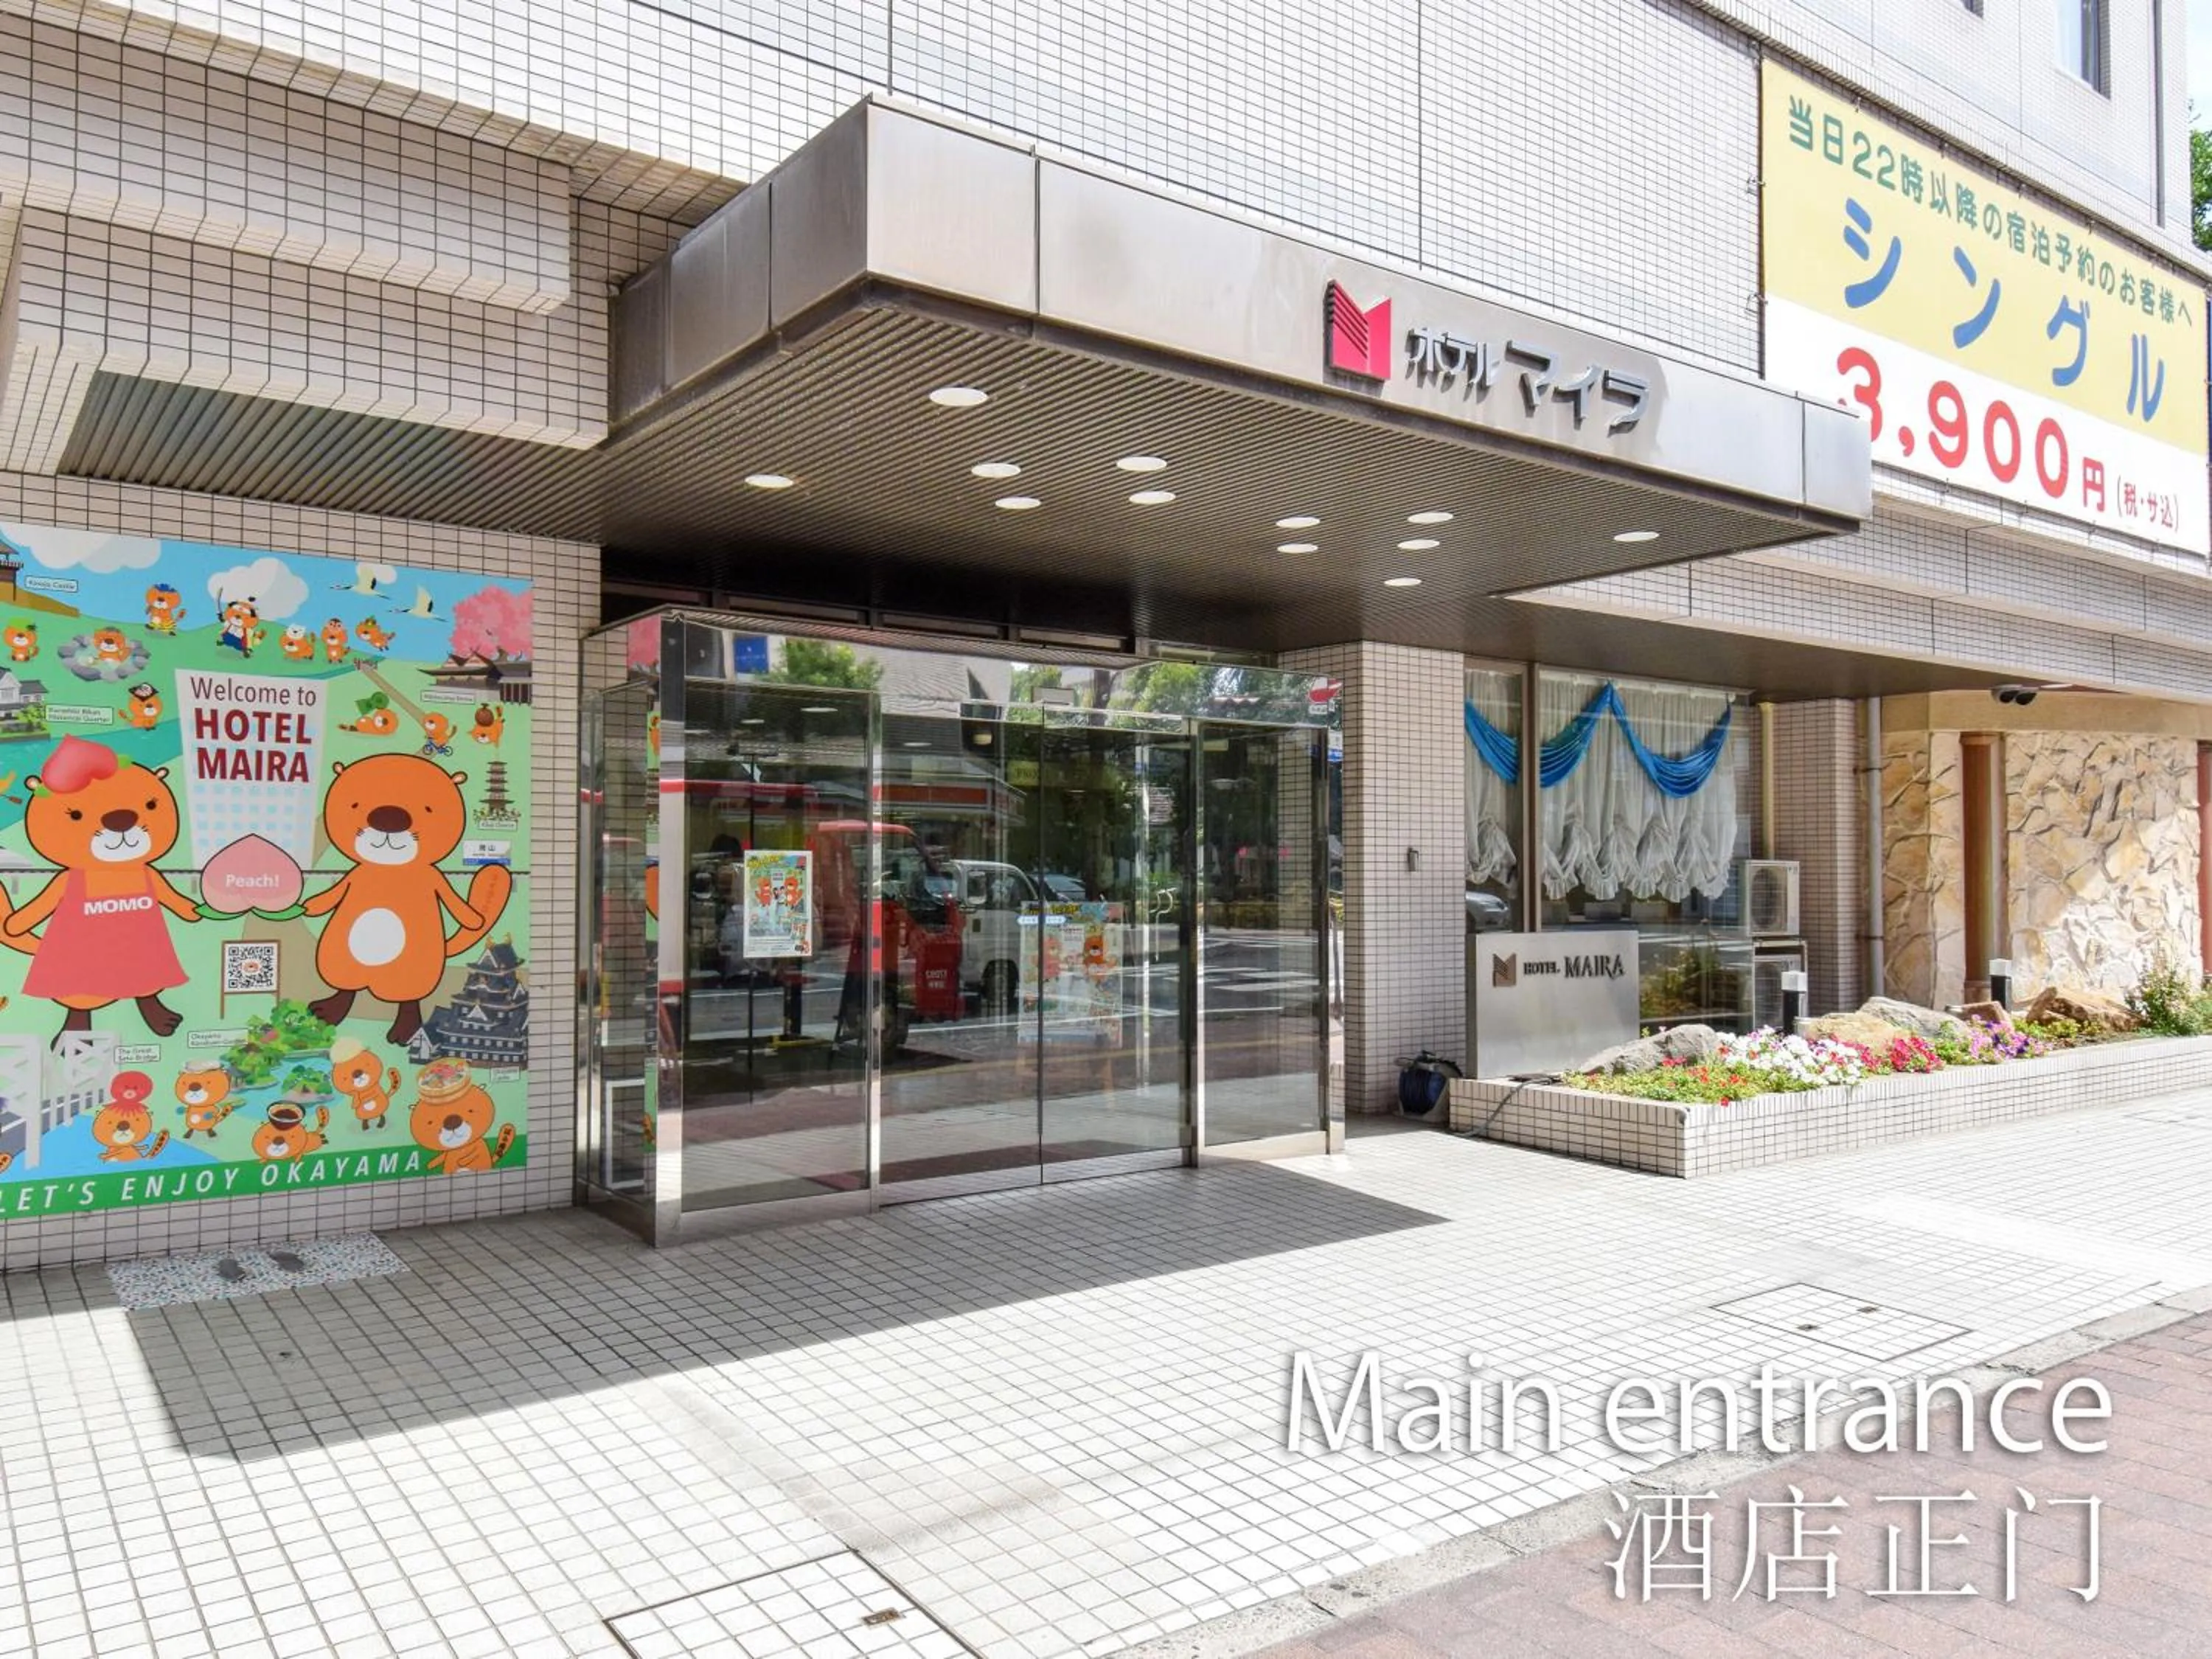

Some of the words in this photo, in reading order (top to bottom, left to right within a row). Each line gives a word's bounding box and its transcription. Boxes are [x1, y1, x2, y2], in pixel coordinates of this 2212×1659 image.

[1789, 96, 2193, 327] 当日22時以降の宿泊予約のお客様へ
[1843, 197, 2165, 423] シングル
[1405, 327, 1500, 389] ホテル
[1506, 338, 1649, 428] マイラ
[190, 675, 291, 706] Welcome
[298, 686, 316, 707] to
[194, 707, 313, 745] HOTEL
[197, 747, 310, 782] MAIRA
[226, 874, 279, 888] Peach!
[83, 896, 153, 915] MOMO
[1563, 955, 1624, 979] MAIRA
[121, 1167, 240, 1201] ENJOY
[261, 1150, 420, 1186] OKAYAMA
